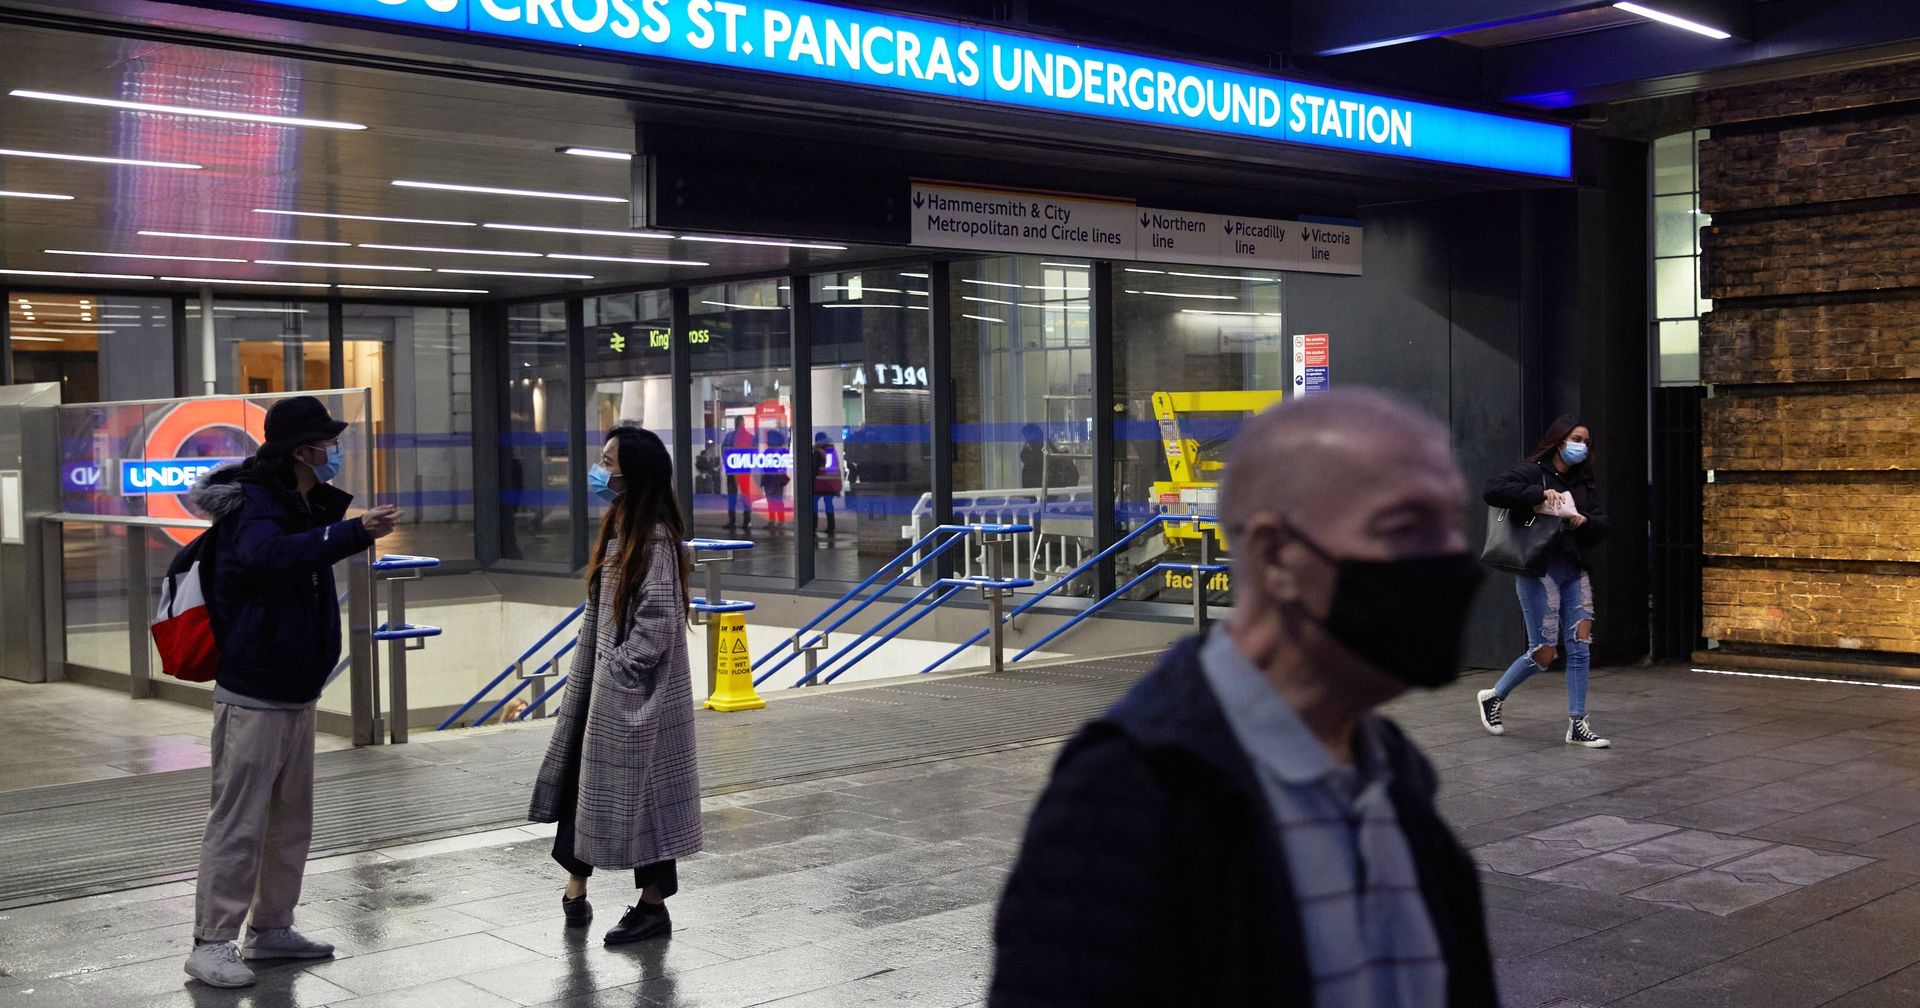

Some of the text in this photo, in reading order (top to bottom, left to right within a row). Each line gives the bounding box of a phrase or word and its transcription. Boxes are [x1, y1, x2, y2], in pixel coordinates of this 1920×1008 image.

[686, 0, 754, 54] ST.
[764, 9, 980, 87] PANCRAS
[992, 45, 1281, 128] UNDERGROUND
[1289, 93, 1412, 147] STATION
[927, 193, 1071, 225] Hammersmith & City
[927, 214, 1122, 245] Metropolitan and Circle lines
[1152, 213, 1206, 233] Northern
[1235, 221, 1286, 243] Piccadilly
[1152, 233, 1175, 249] line
[1235, 239, 1256, 255] line
[1311, 228, 1351, 245] Victoria
[1311, 245, 1330, 261] line
[650, 328, 710, 350] King' ross
